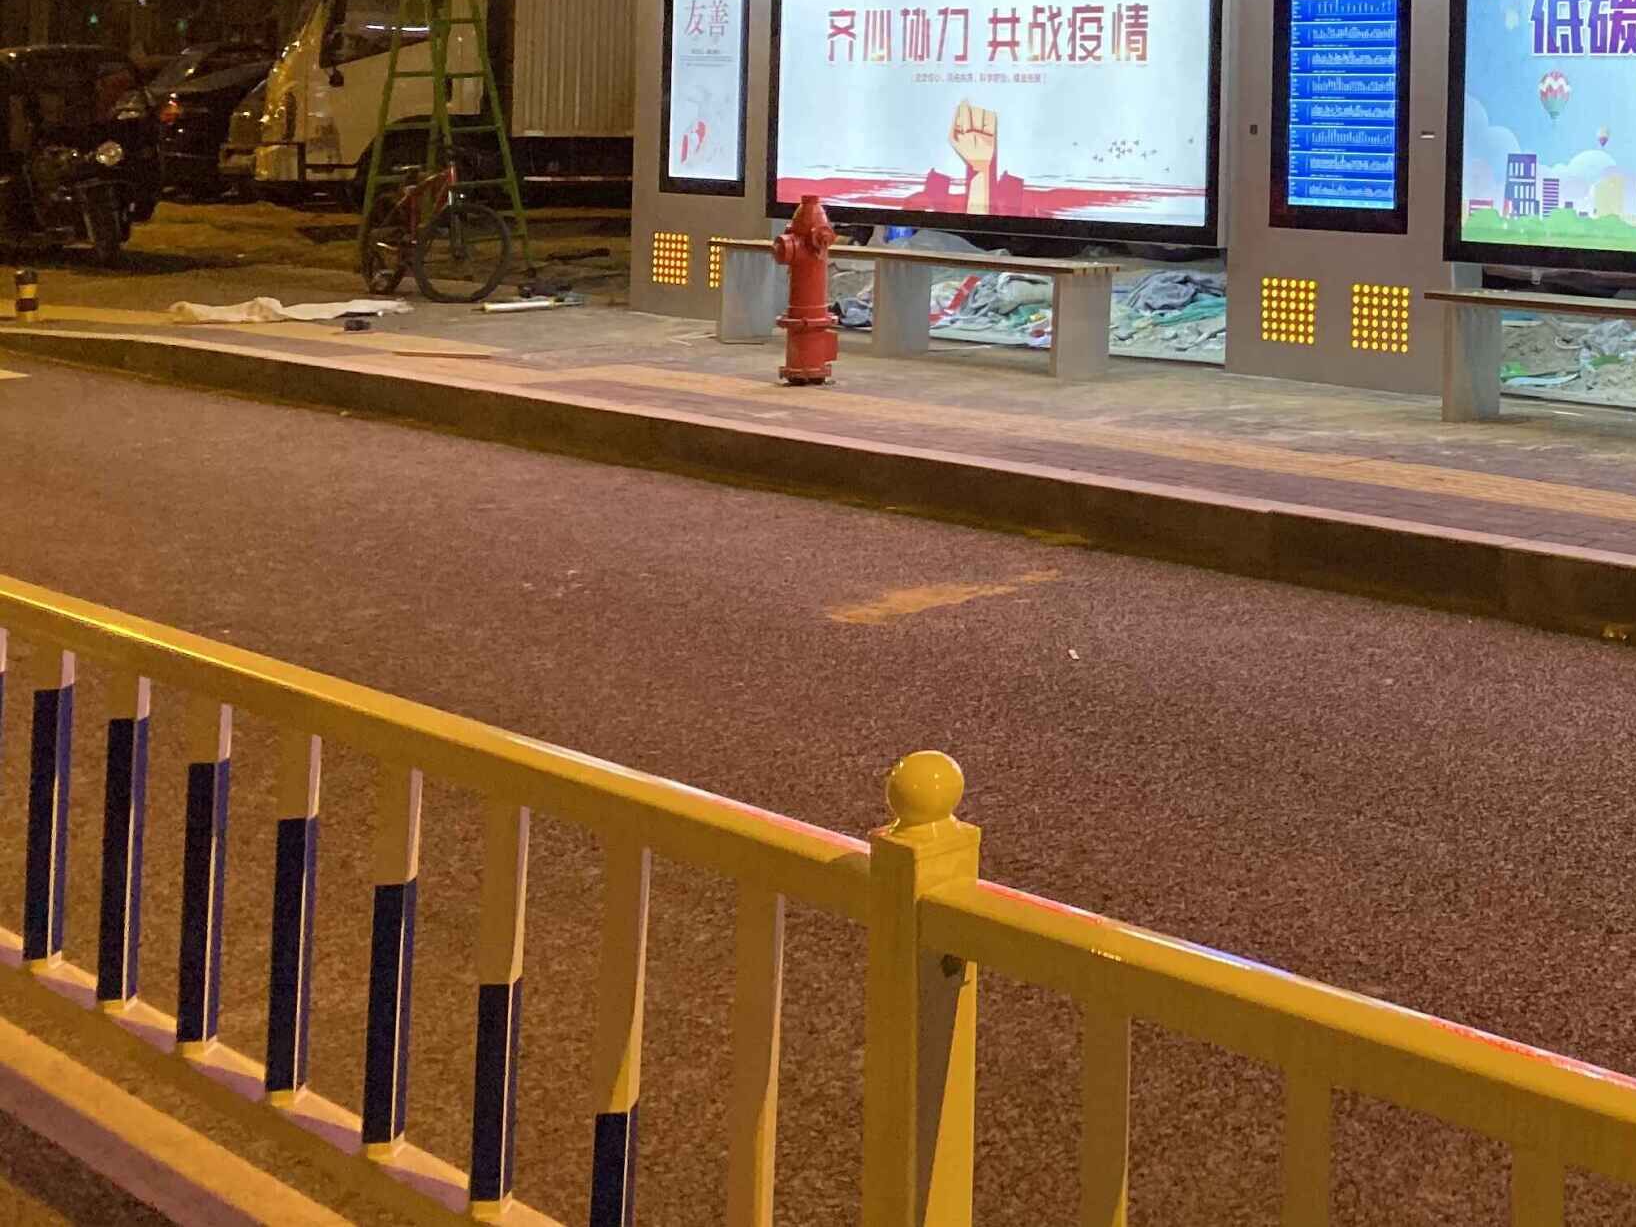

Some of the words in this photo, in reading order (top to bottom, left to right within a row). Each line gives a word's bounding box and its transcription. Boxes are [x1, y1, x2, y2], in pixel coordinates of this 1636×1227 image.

[826, 7, 970, 63] 齐心协力
[987, 2, 1150, 64] 共战疫情
